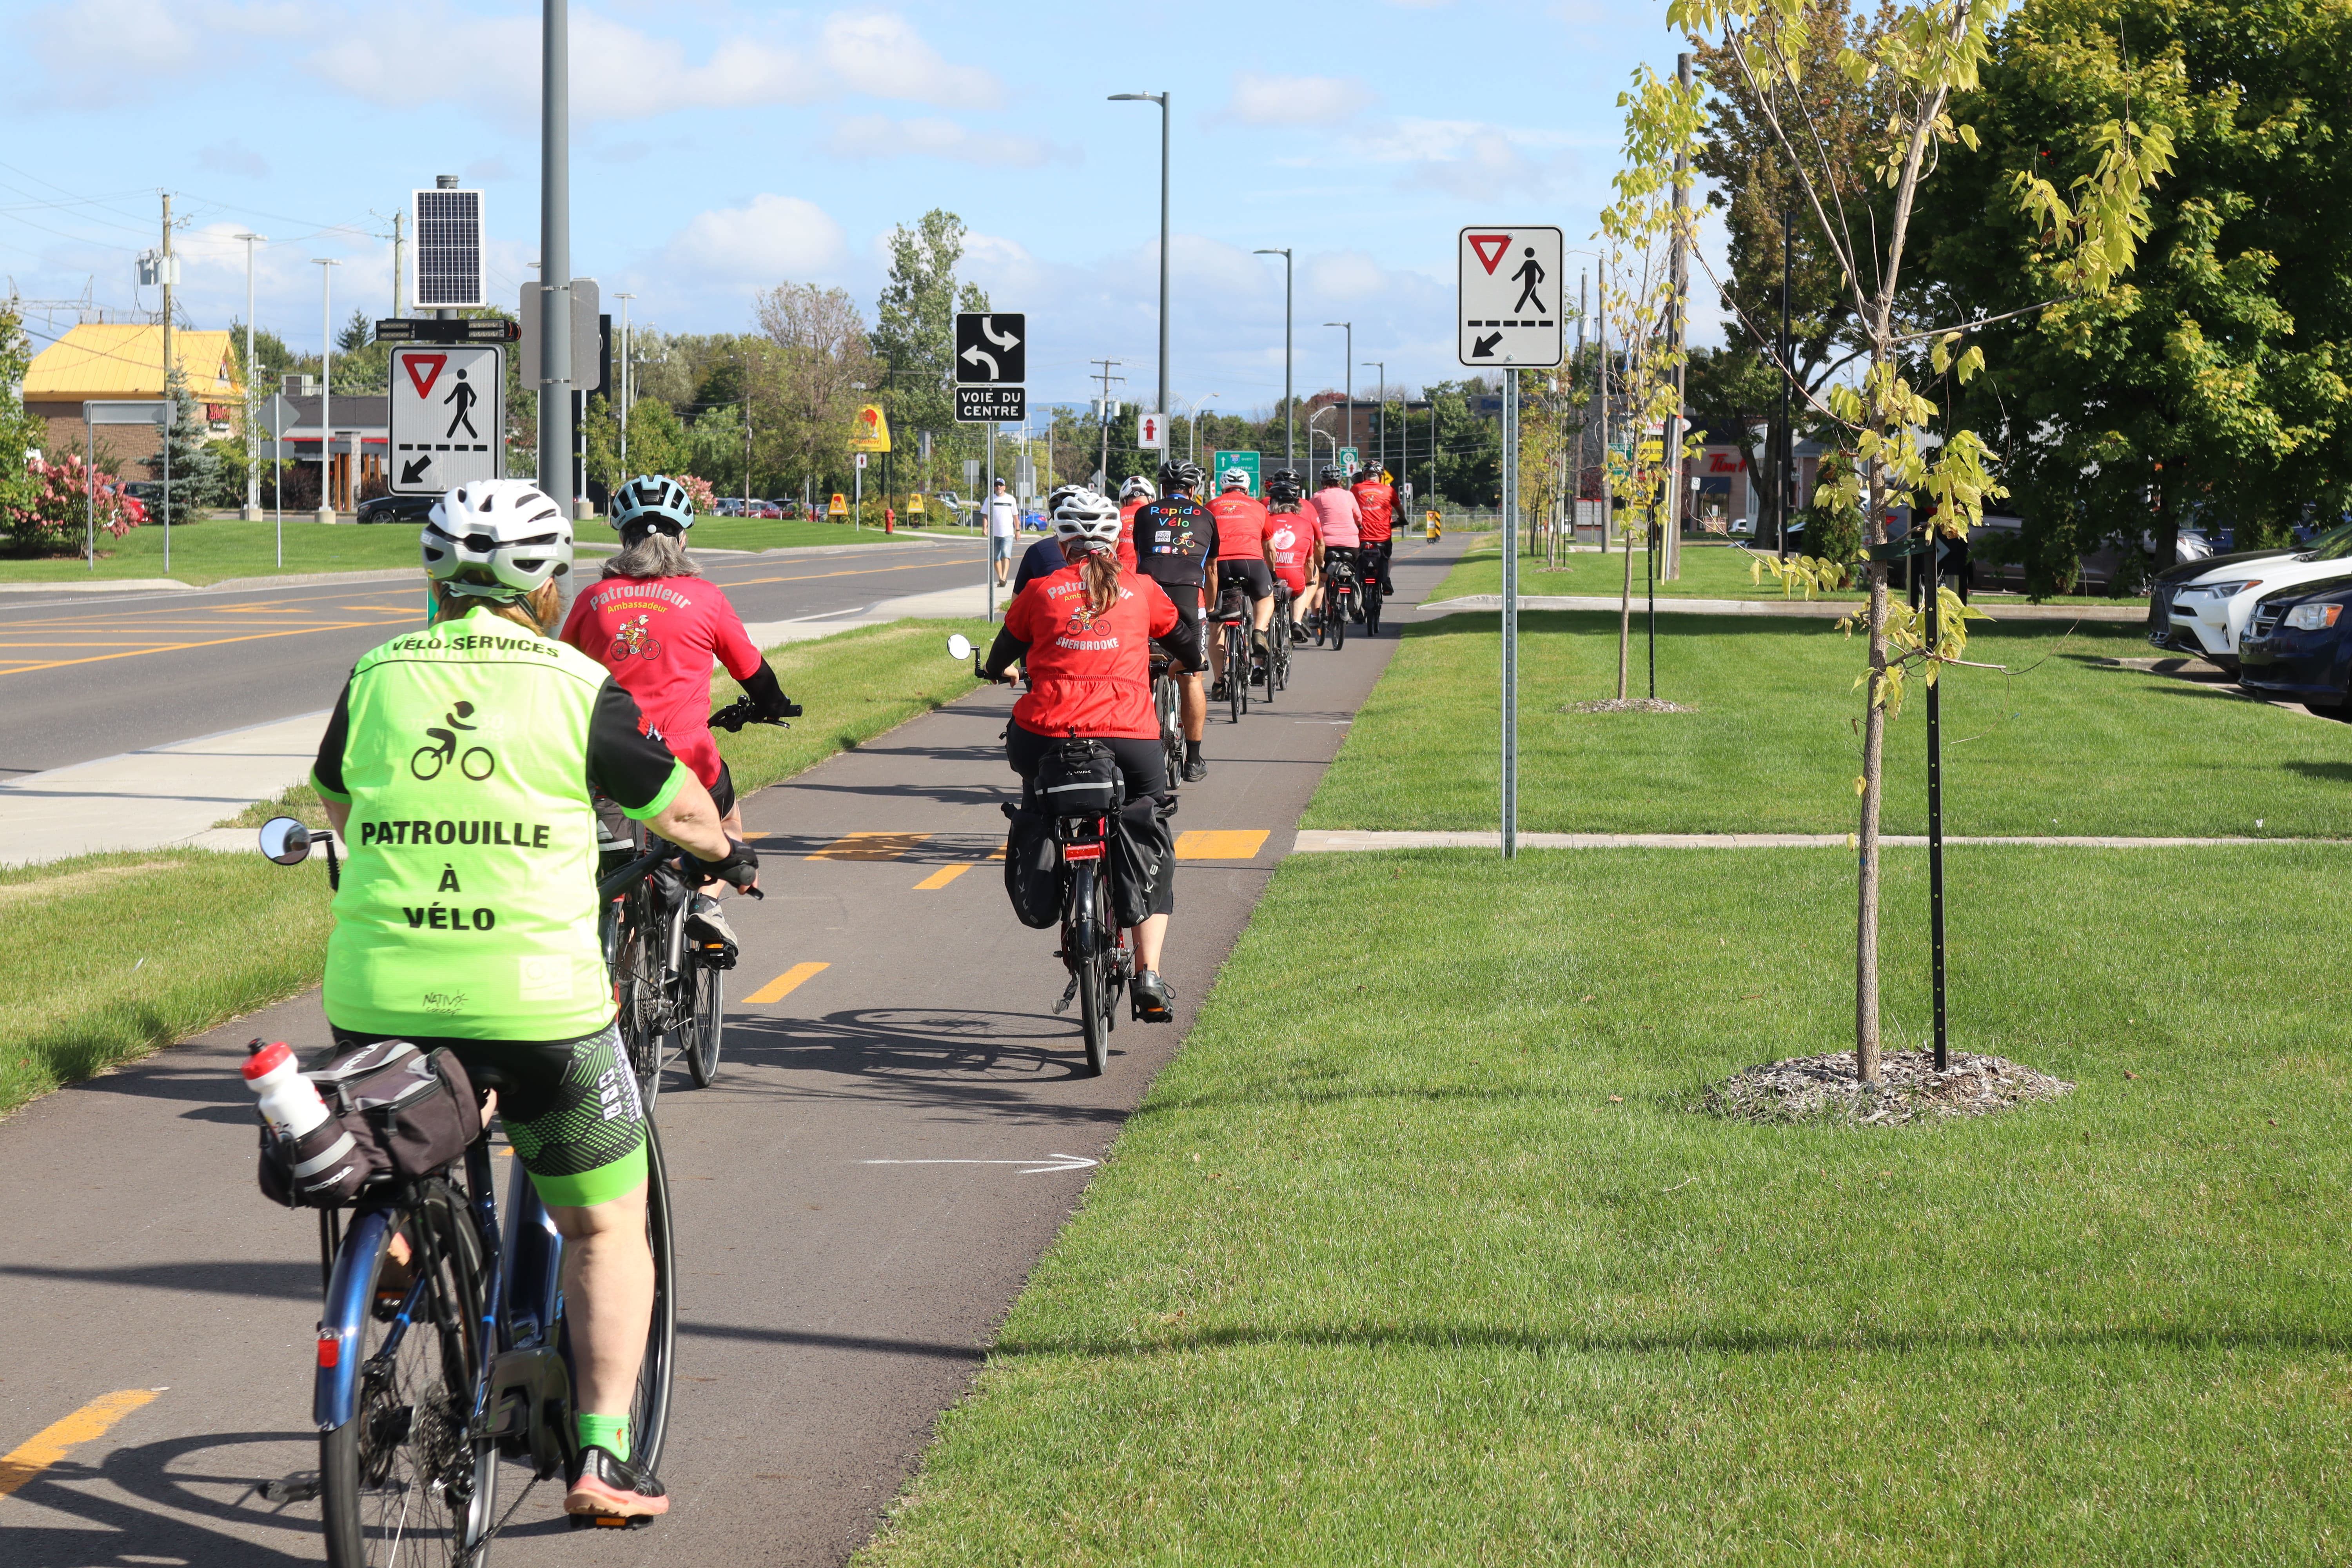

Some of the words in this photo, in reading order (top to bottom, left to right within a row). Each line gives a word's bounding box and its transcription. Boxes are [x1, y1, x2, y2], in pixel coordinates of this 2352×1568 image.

[961, 392, 993, 403] VOIE
[1002, 392, 1020, 403] DU
[964, 406, 1018, 416] CENTRE
[1709, 453, 1738, 473] Tim
[1150, 506, 1201, 516] Rapido
[1159, 517, 1190, 528] Vélo
[1275, 552, 1294, 564] SADEUR
[590, 583, 691, 611] Patrouilleur
[1047, 581, 1134, 600] Patrour
[607, 601, 668, 614] Ambassadeur
[392, 635, 559, 657] VÉLO-SERVICES
[1056, 636, 1119, 651] SHERBROOKE
[361, 820, 550, 849] PATROUILLE
[438, 863, 461, 892] À
[402, 902, 495, 931] VÉLO
[612, 1041, 629, 1093] PATROUILLE
